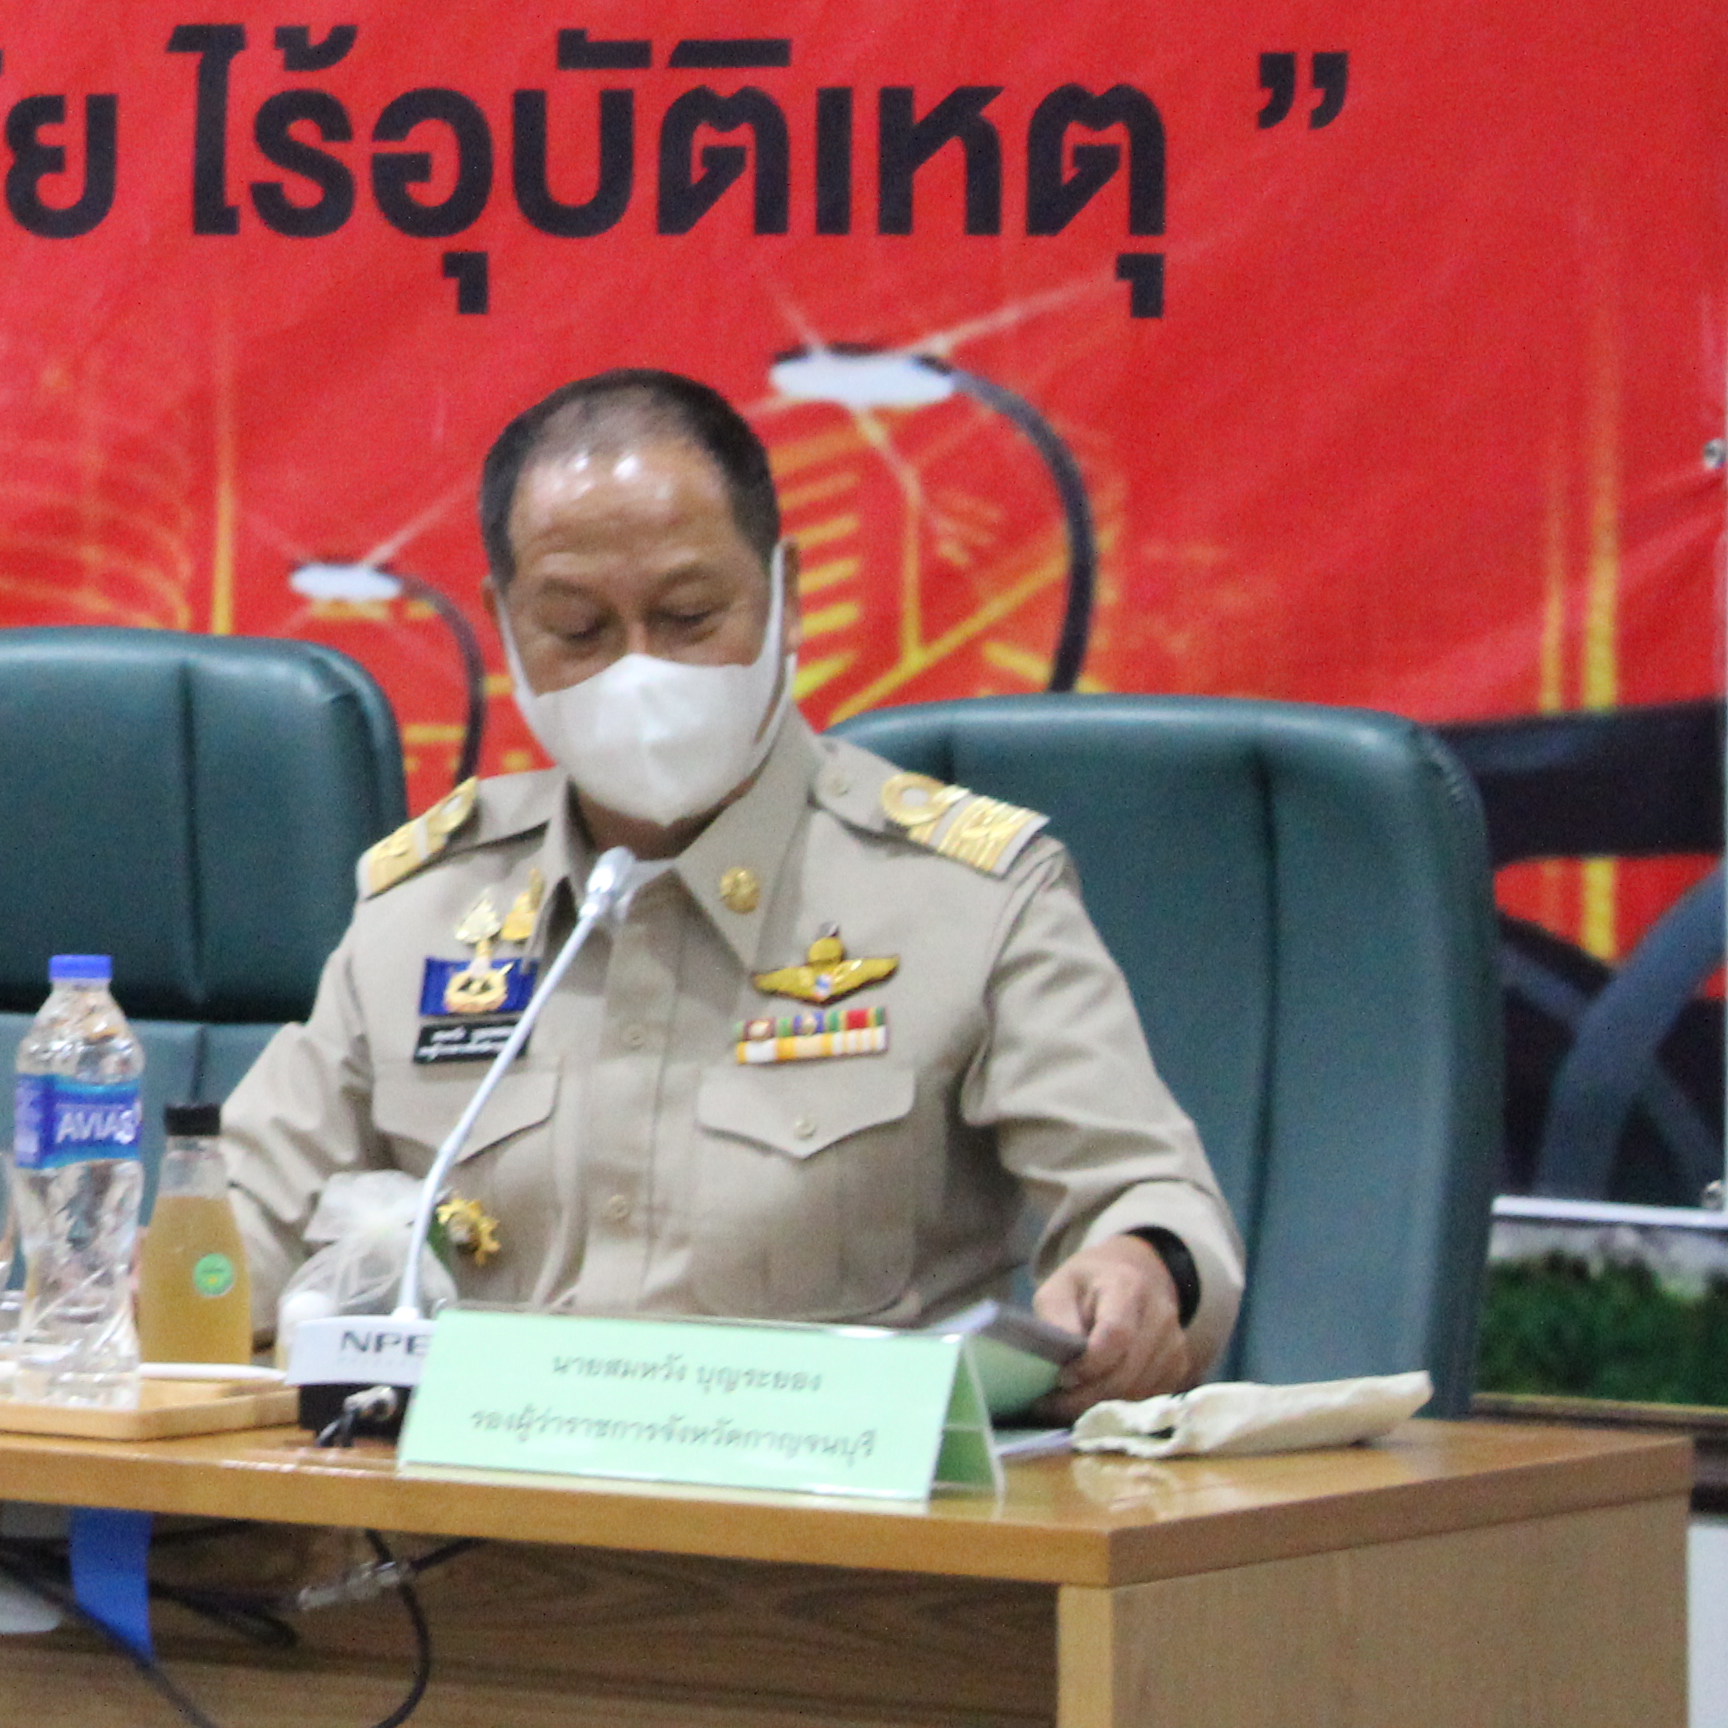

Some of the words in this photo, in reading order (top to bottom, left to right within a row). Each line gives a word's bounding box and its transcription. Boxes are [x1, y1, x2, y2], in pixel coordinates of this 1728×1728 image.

[166, 23, 1167, 320] ไร้อุบัติเหตุ
[341, 1330, 432, 1357] NPE
